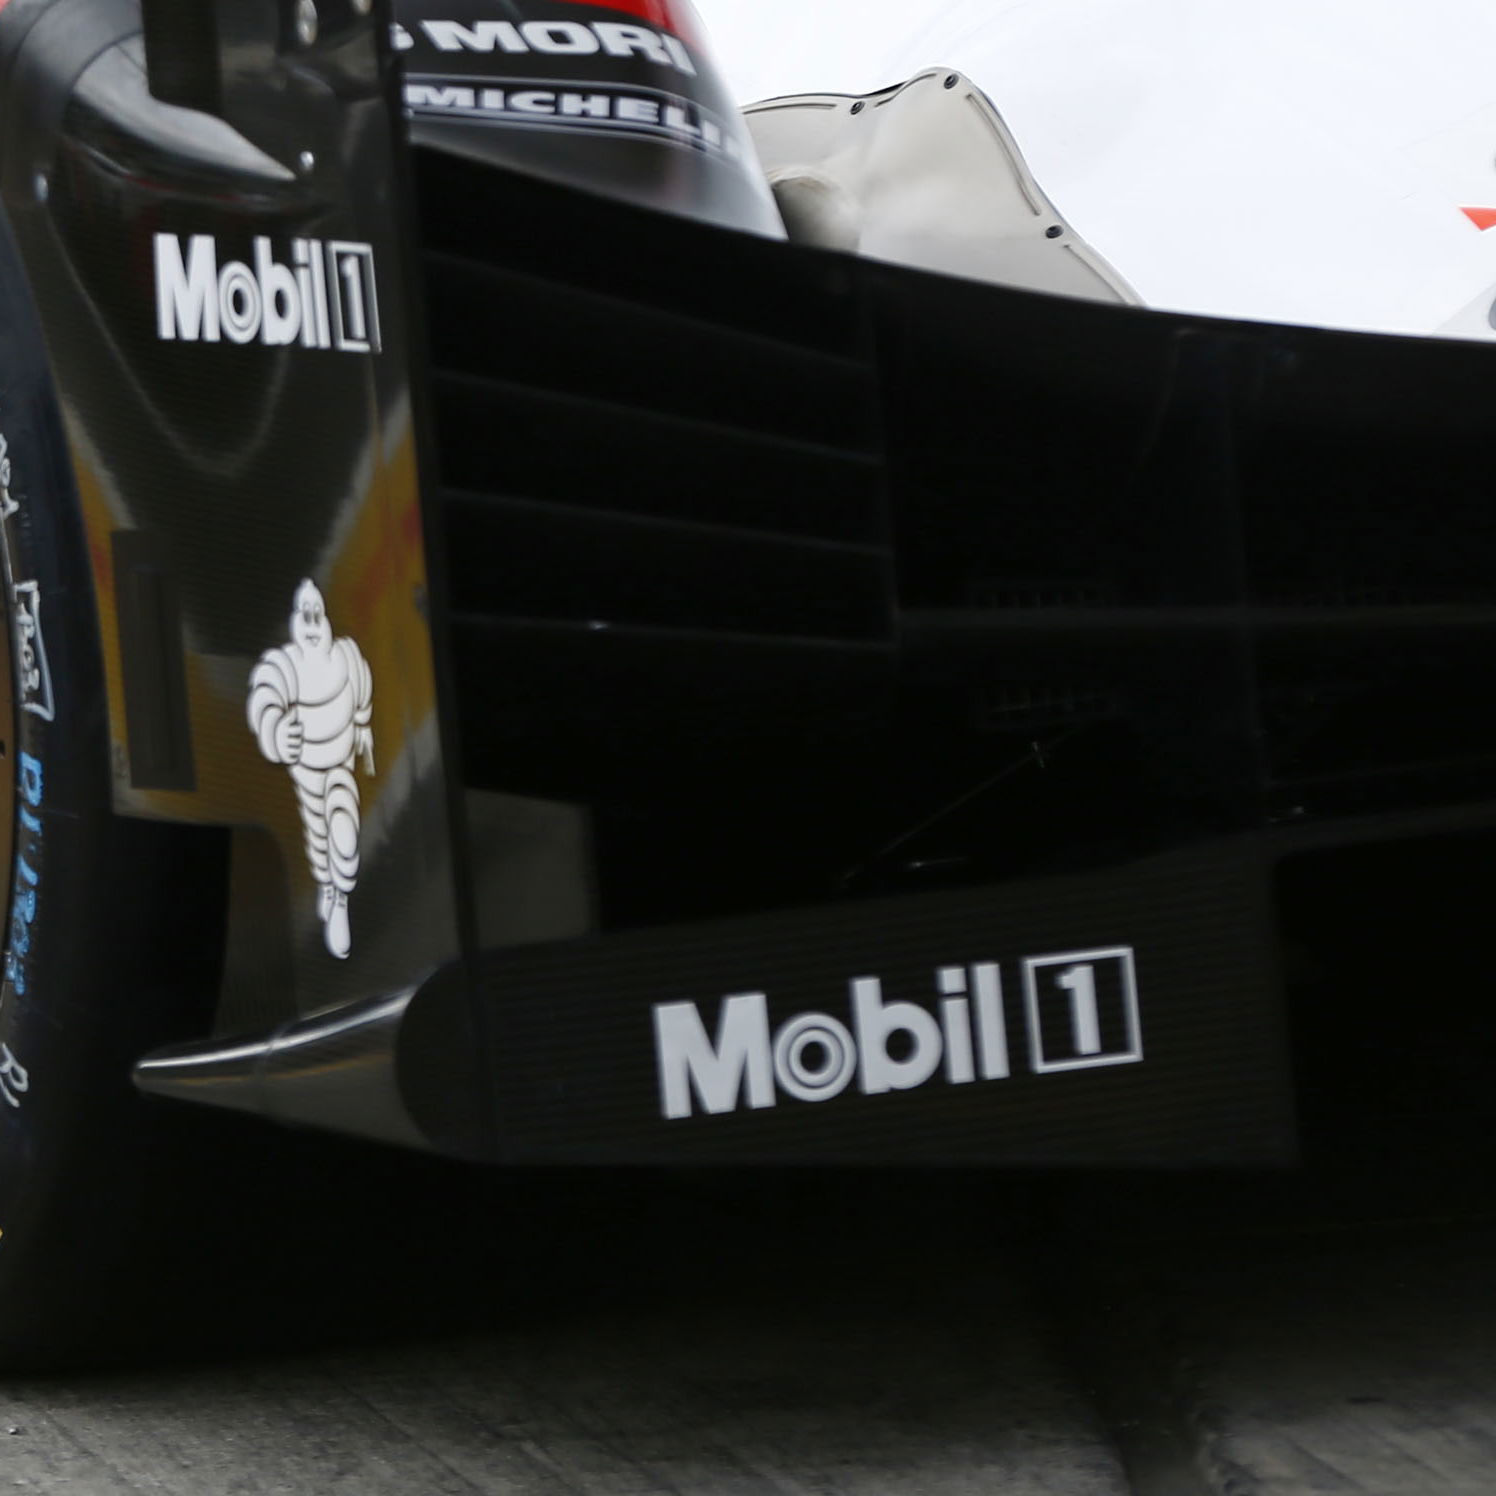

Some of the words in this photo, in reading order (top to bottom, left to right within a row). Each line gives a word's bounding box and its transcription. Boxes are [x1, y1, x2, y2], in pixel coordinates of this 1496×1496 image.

[418, 21, 698, 78] MORI
[154, 232, 331, 349] Mobil
[654, 961, 1011, 1120] Mobil
